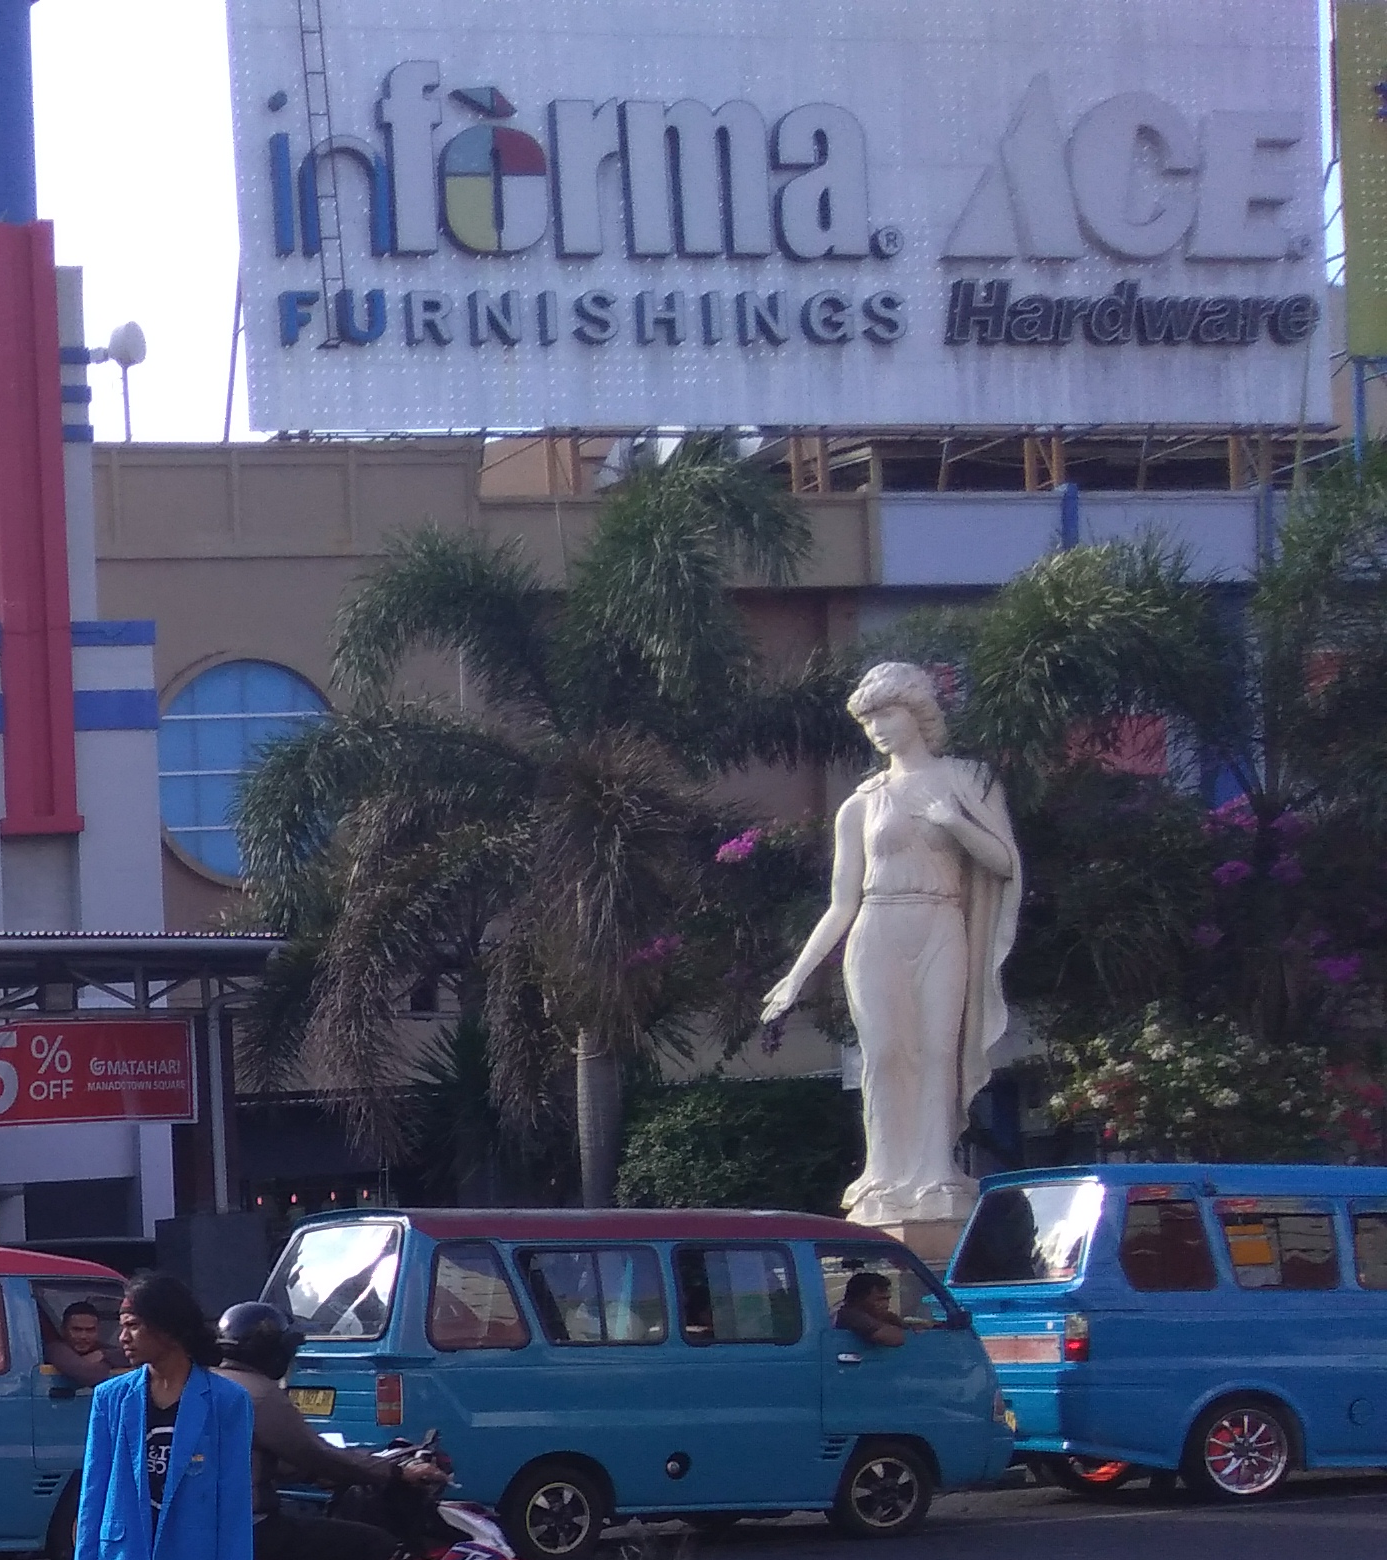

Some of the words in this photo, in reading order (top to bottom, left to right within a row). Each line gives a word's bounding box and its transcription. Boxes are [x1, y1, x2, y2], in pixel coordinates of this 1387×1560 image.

[938, 68, 1308, 264] ACE
[277, 289, 909, 347] FURNISHINGS
[944, 278, 1319, 346] Hardware
[29, 1079, 73, 1100] OFF
[107, 1060, 181, 1075] MATAHARI
